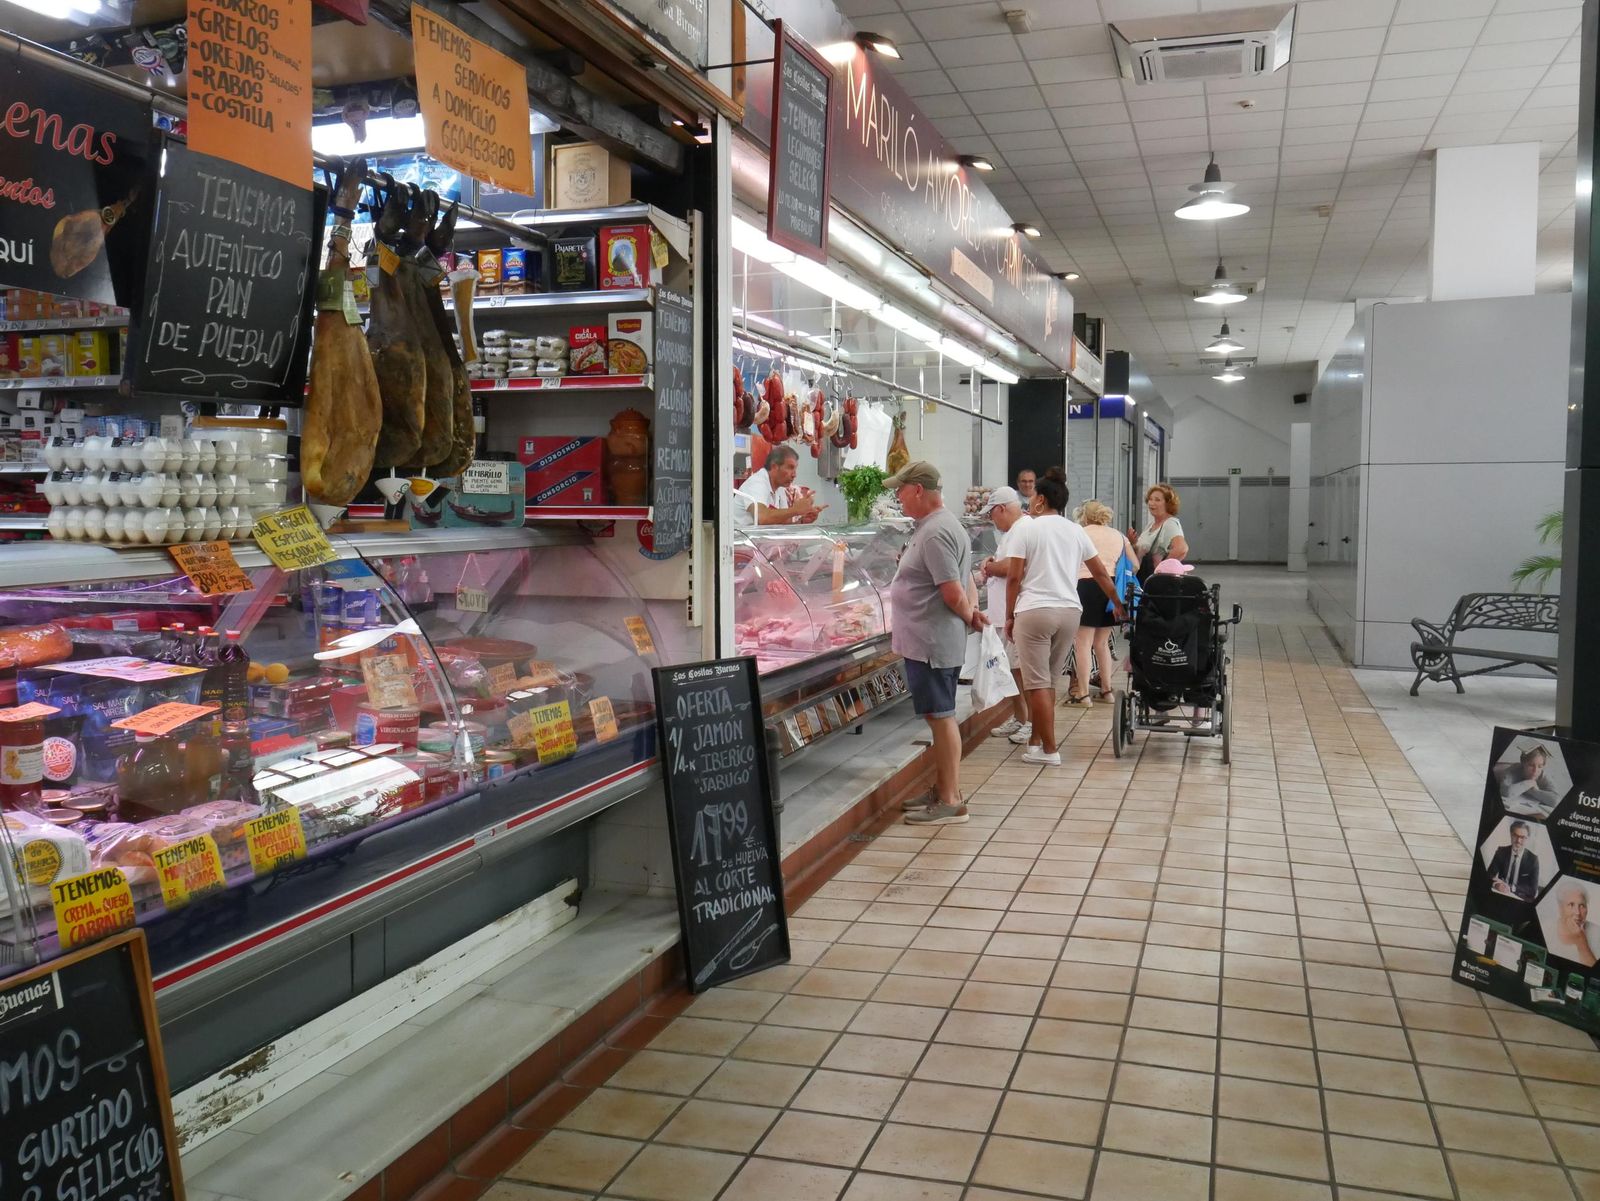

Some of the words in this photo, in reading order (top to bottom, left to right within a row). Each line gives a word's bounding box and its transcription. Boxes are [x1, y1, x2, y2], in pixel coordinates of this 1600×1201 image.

[416, 14, 472, 63] TENEMOS
[432, 82, 441, 104] A
[0, 101, 118, 166] enas
[788, 101, 821, 143] TENEMOS
[847, 58, 920, 192] MARILÓ
[197, 171, 296, 236] TENEMOS
[205, 276, 254, 319] PAN
[158, 321, 191, 352] DE
[538, 440, 581, 467] CONSORCIO
[536, 475, 578, 503] CONSORCIO
[676, 686, 733, 720] OFERTA
[249, 809, 291, 836] TENEMOS
[154, 836, 207, 869] TENEMOS
[735, 847, 769, 865] HUELVA
[55, 867, 122, 904] TENEMOS
[693, 878, 713, 897] AL
[715, 865, 757, 892] CORTE
[63, 901, 96, 924] CREMA
[102, 892, 130, 913] QUESO
[69, 907, 135, 946] CABRALES
